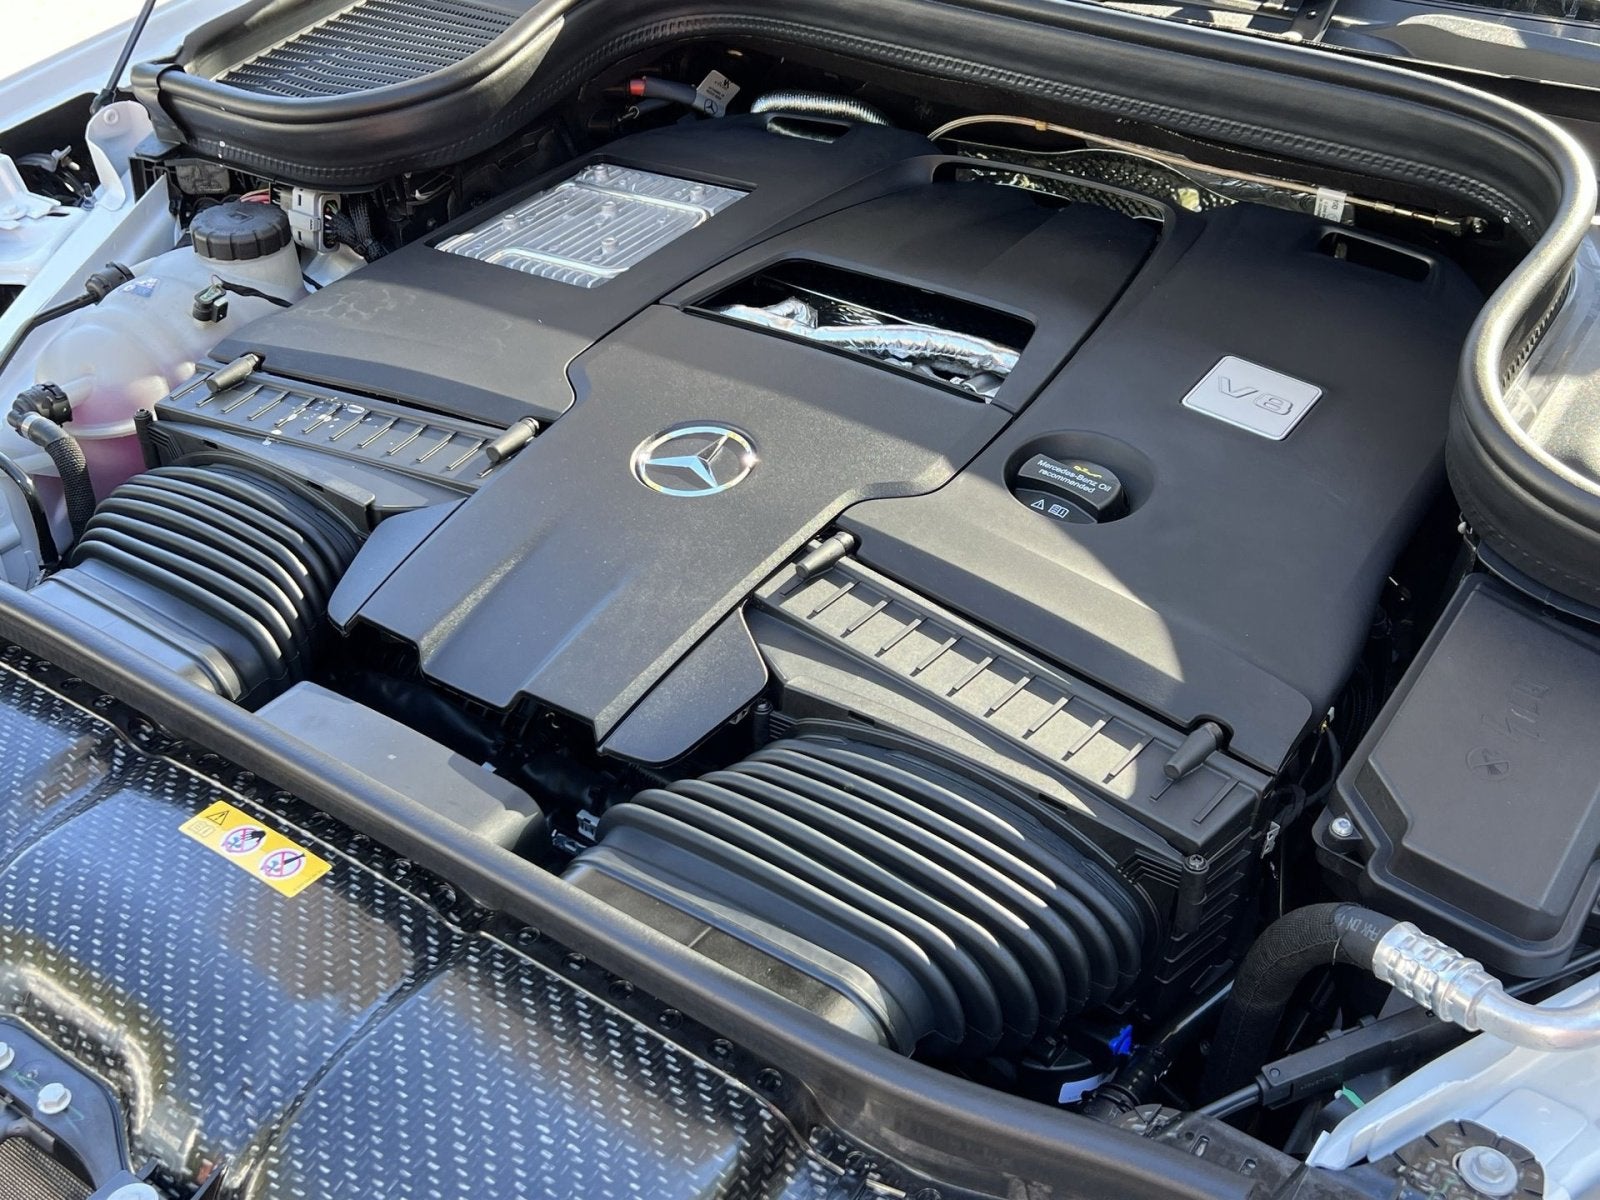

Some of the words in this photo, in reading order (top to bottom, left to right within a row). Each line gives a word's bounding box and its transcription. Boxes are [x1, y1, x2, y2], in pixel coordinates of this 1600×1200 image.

[1219, 376, 1293, 415] V8
[1037, 460, 1098, 487] Mercedes-Benz
[1098, 483, 1112, 492] Oil
[1038, 468, 1096, 493] recommended
